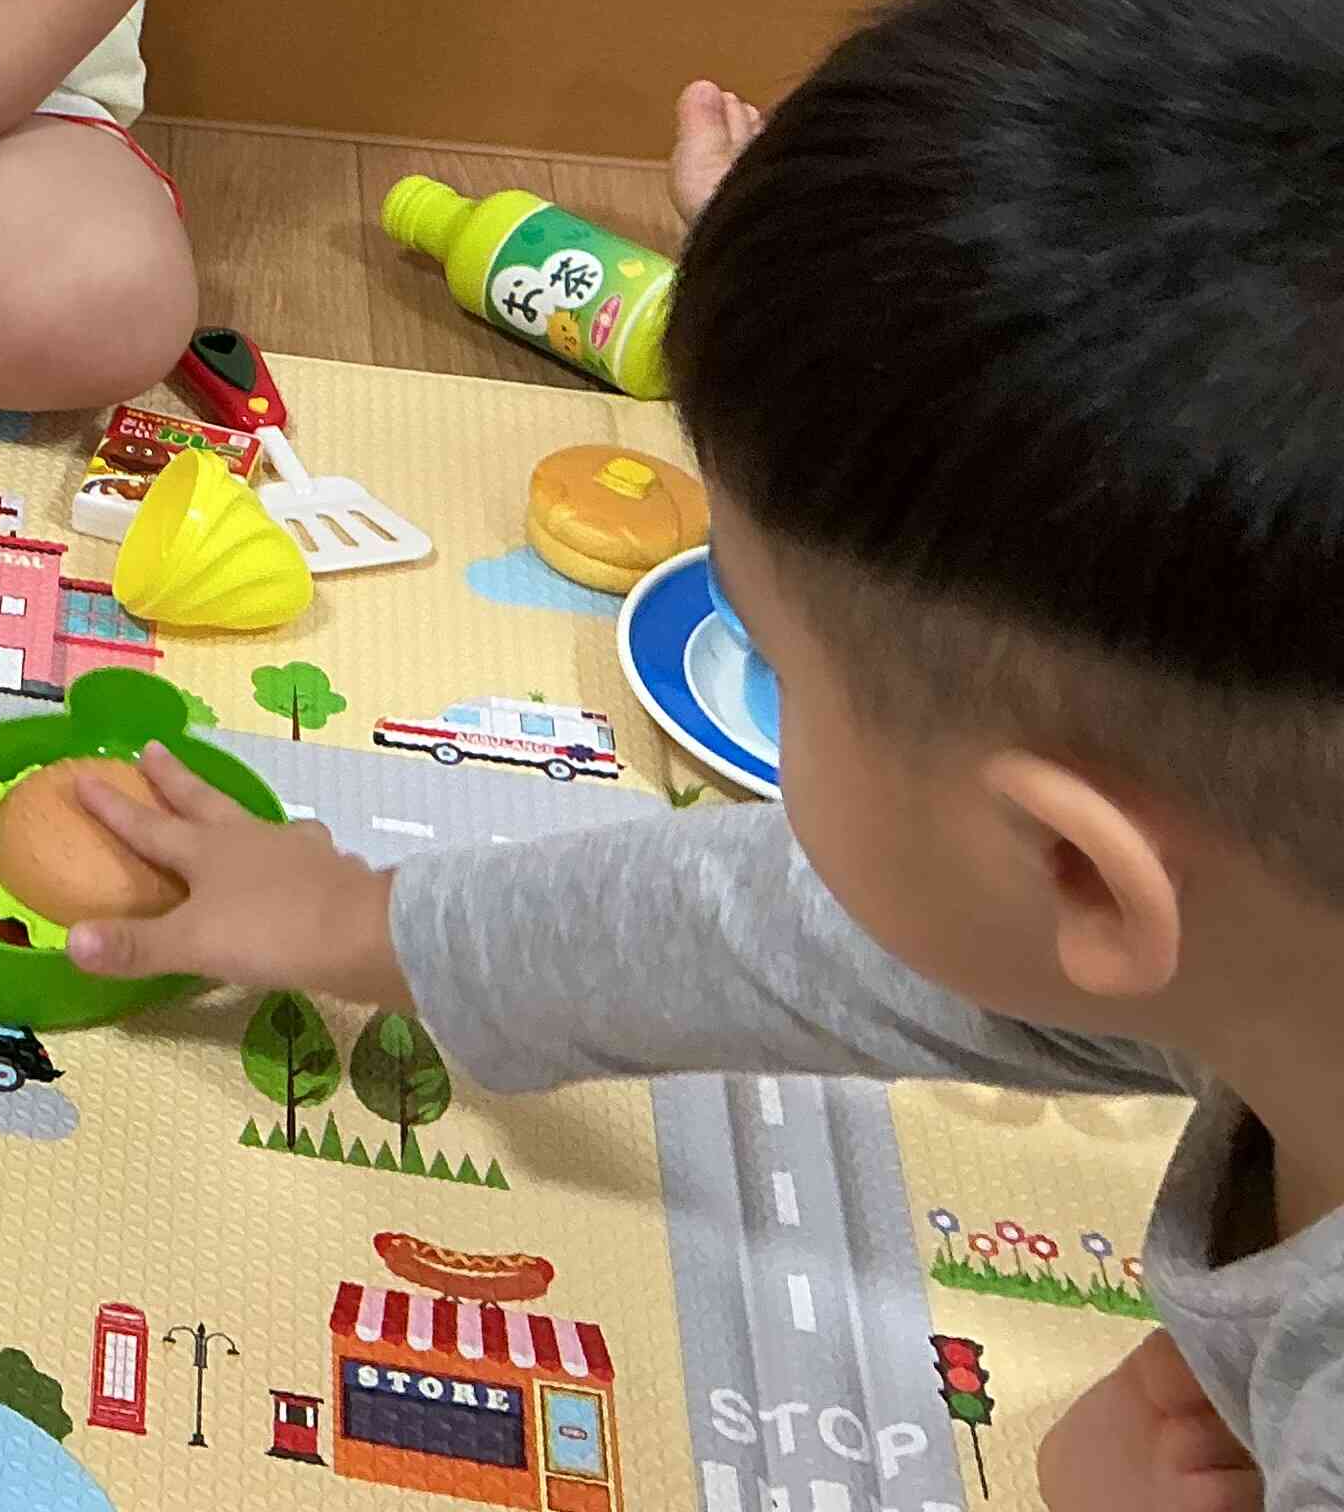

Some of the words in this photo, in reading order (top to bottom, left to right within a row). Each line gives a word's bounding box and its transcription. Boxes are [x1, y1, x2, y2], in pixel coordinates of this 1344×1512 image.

[502, 256, 599, 324] お茶
[455, 731, 555, 755] AMBULANCE
[357, 1364, 511, 1413] STORE
[709, 1387, 929, 1481] STOP
